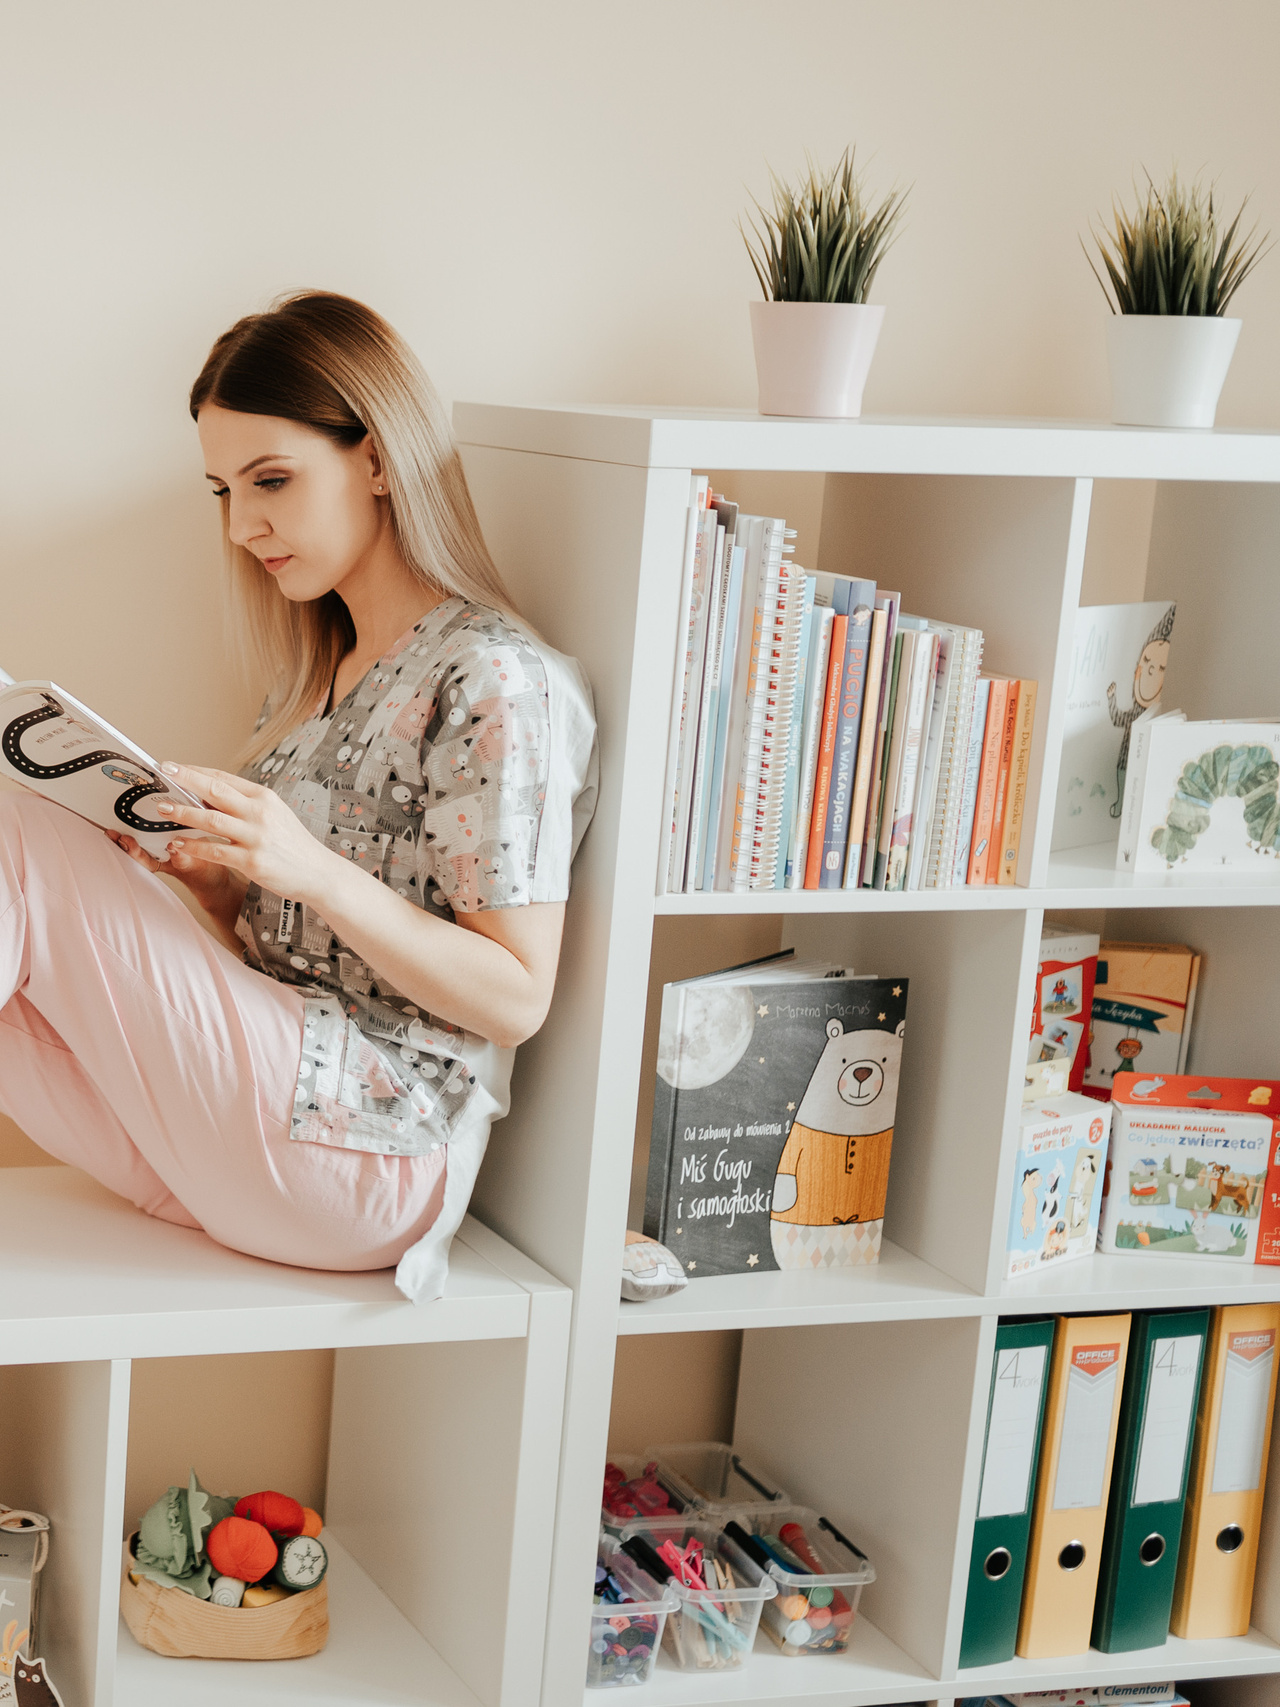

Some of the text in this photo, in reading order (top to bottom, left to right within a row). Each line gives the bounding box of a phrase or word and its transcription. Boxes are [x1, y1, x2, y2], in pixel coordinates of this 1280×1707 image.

[724, 543, 733, 573] LOGOTOMY
[721, 578, 730, 605] GŁOSKAMI
[718, 606, 726, 630] SZEREGU
[830, 662, 840, 697] Aleksandra
[842, 726, 853, 745] NA
[1021, 732, 1030, 746] Do
[816, 766, 828, 832] BAJKOWA KRAINA
[833, 750, 850, 832] WAKACJACH
[1012, 782, 1024, 824] króliczku
[1104, 1004, 1144, 1022] Języka
[684, 1120, 791, 1144] Od zabawy do mówienia 2
[1032, 1128, 1052, 1142] puzzle
[1129, 1122, 1226, 1134] UKŁADANKI MALUCHA
[1128, 1132, 1143, 1142] Co
[1178, 1134, 1264, 1151] zwierzęta?
[680, 1148, 752, 1194] Miś Gugu
[677, 1183, 772, 1228] i samogłoski
[1233, 1334, 1271, 1346] OFFICE
[1076, 1349, 1116, 1360] OFFICE
[1104, 1683, 1169, 1697] Clementoni
